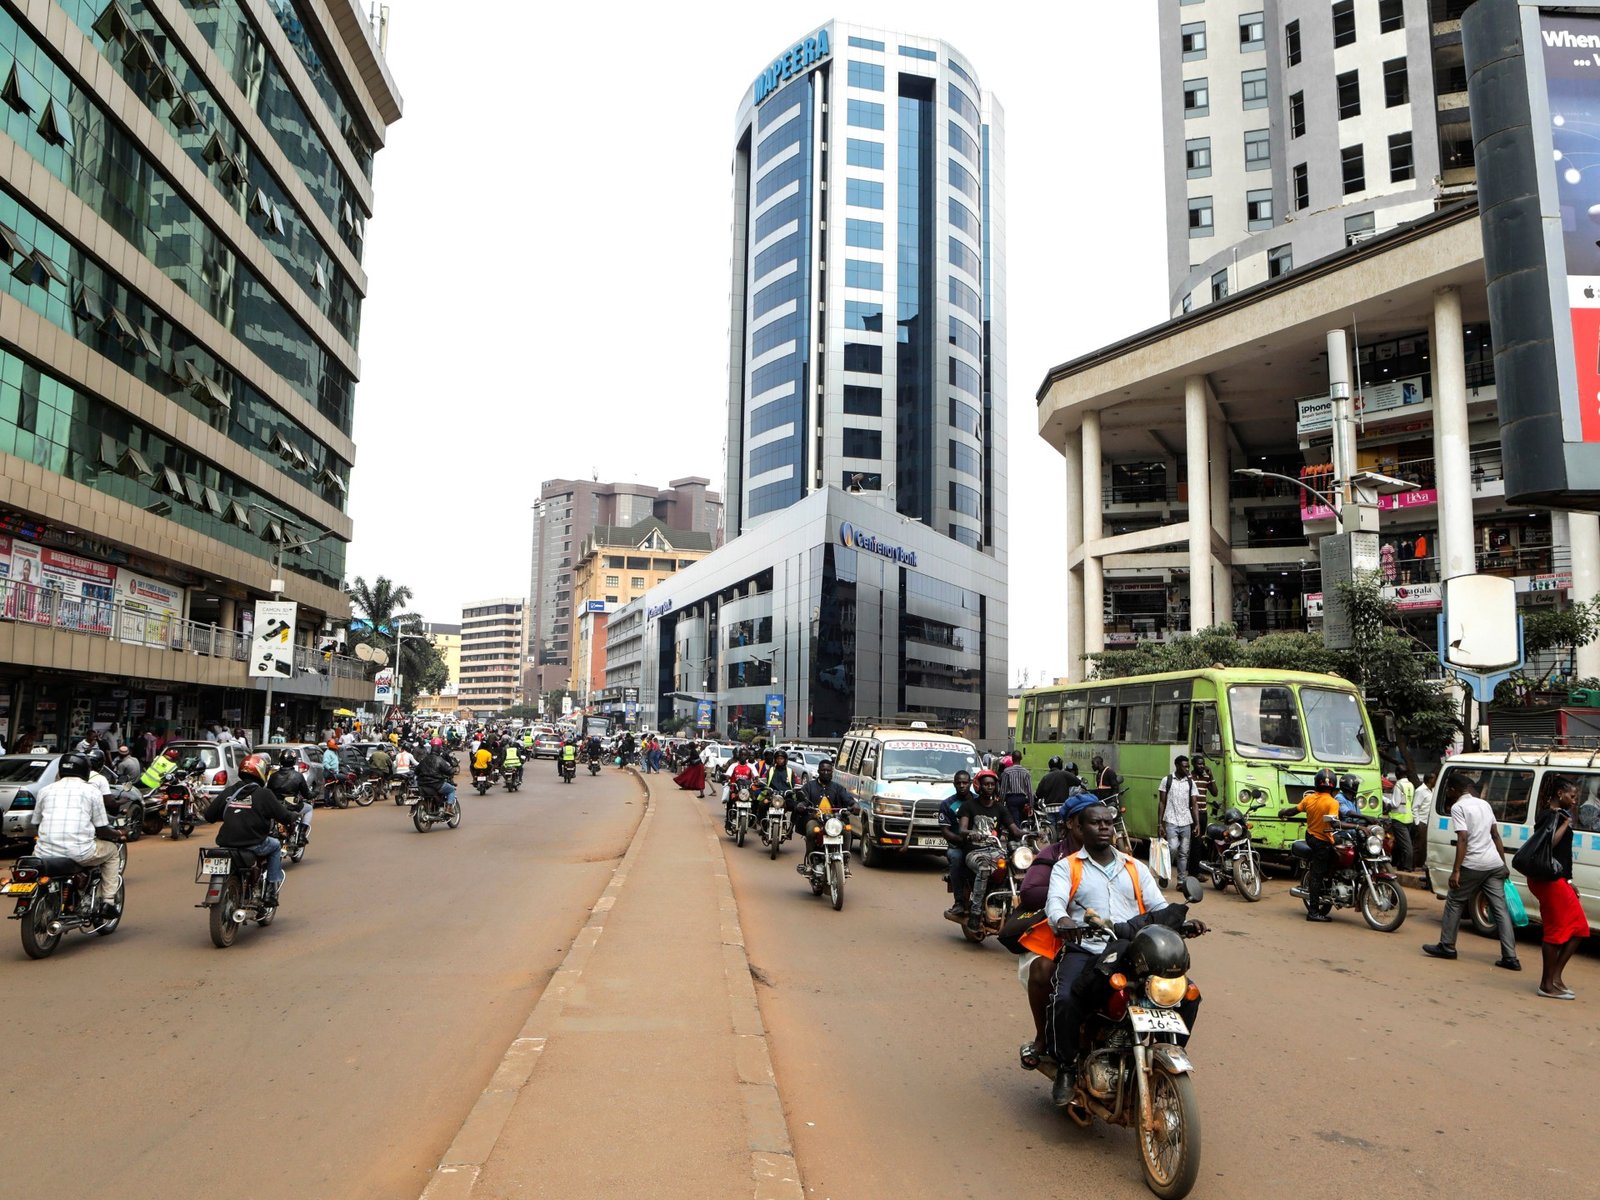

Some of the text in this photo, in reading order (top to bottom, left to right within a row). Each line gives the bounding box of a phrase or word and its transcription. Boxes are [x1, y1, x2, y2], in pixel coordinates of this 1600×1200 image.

[754, 29, 829, 106] MAPEERA
[1301, 402, 1332, 414] iPhone
[854, 529, 901, 564] Centenary
